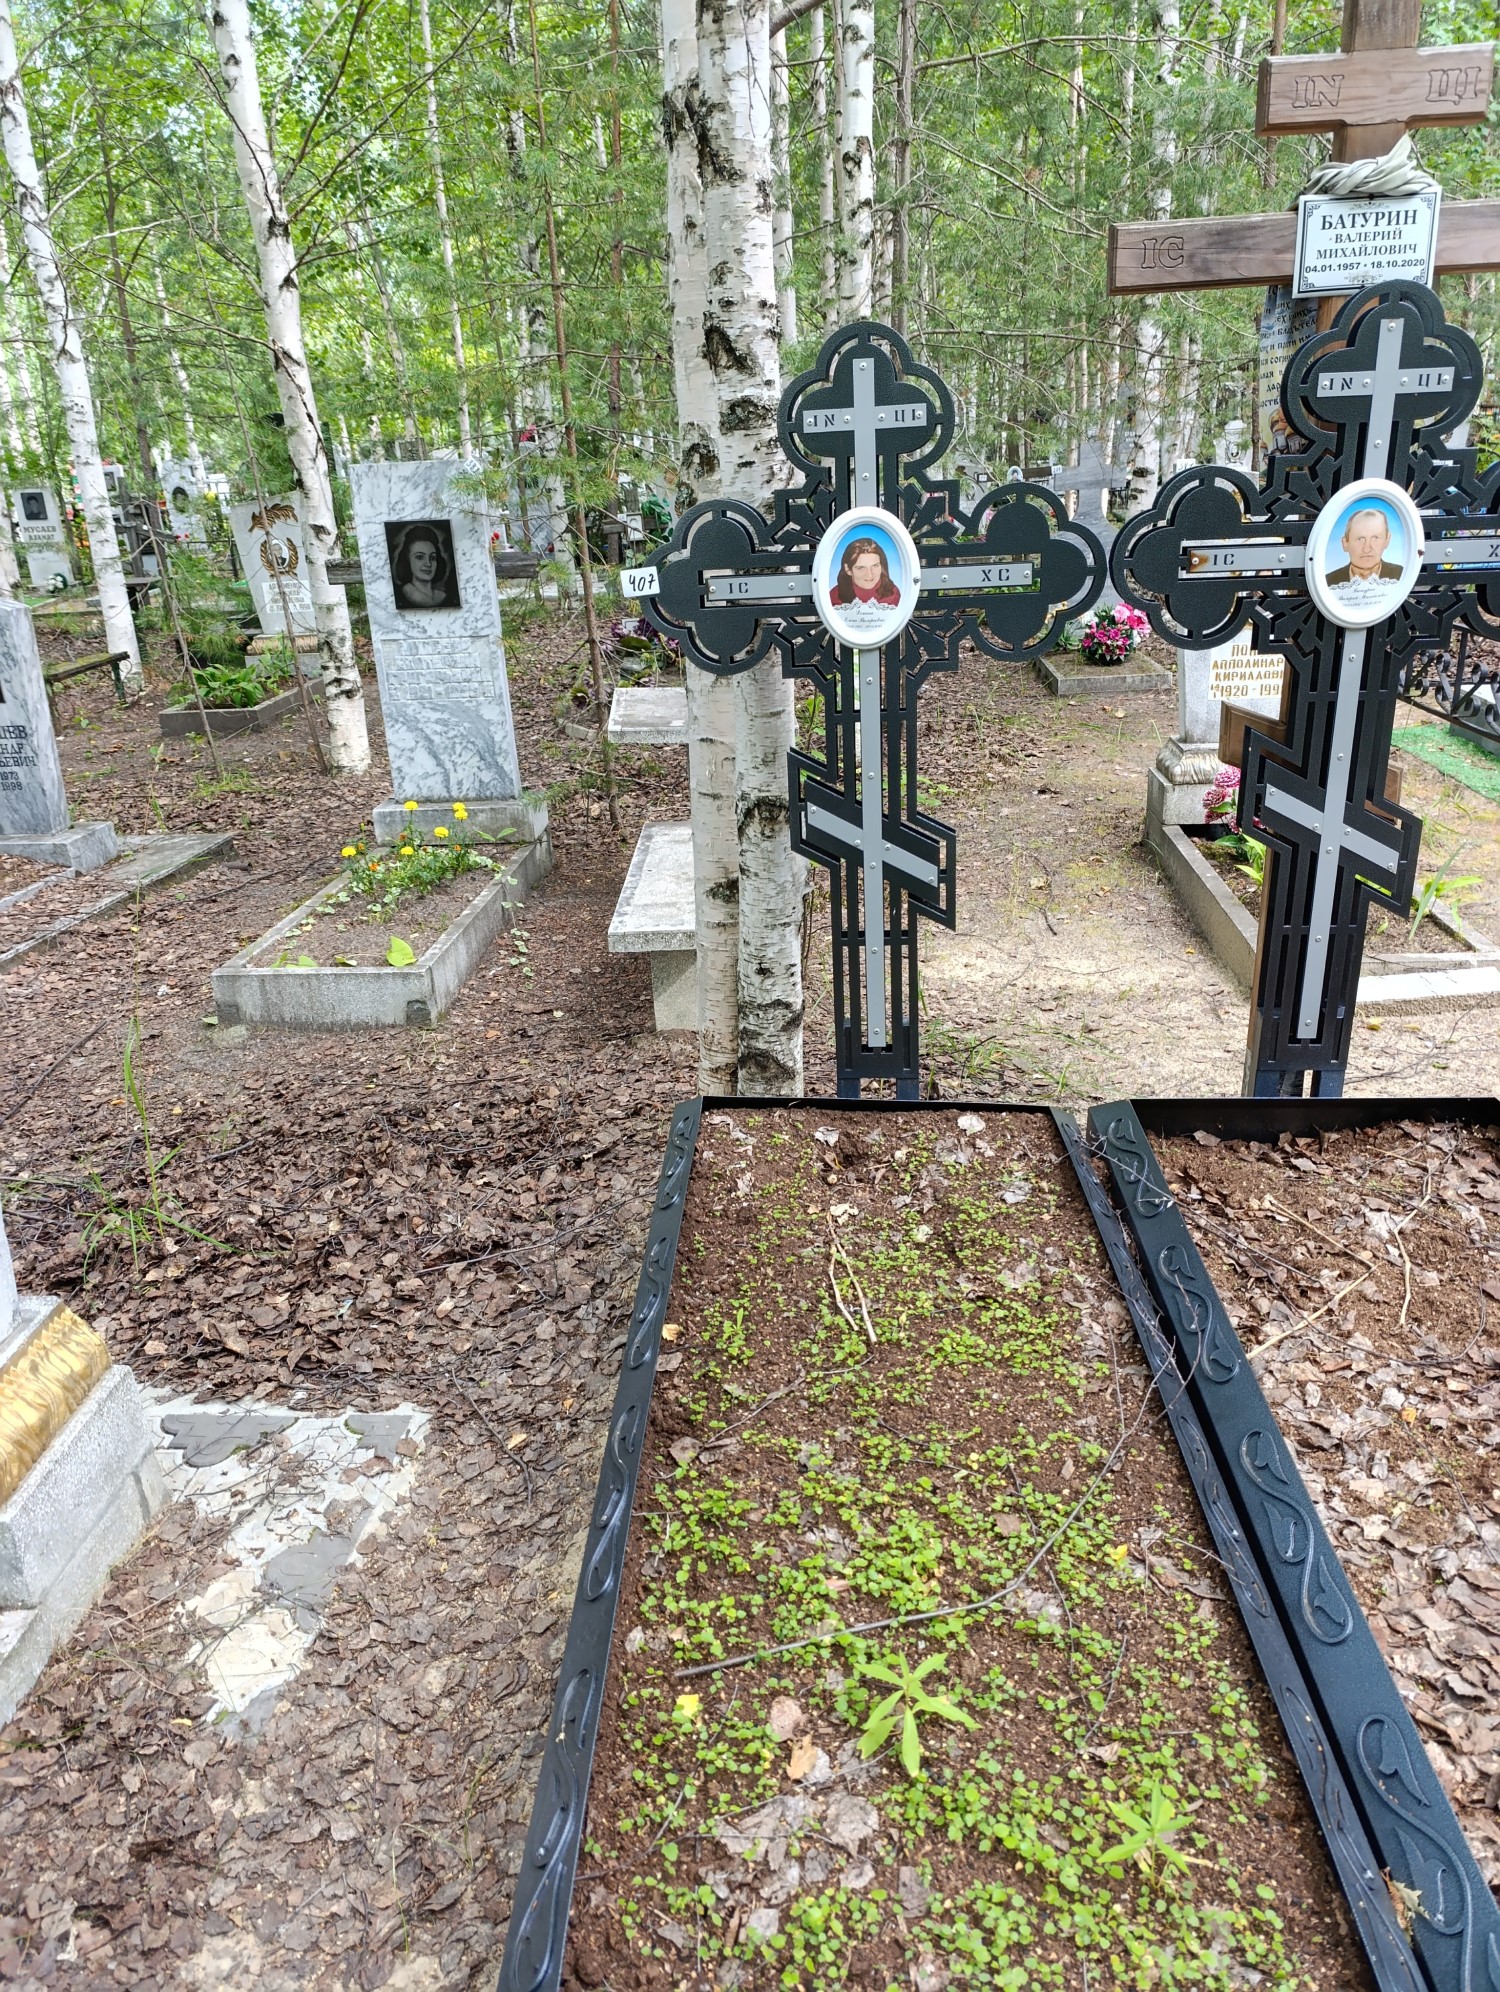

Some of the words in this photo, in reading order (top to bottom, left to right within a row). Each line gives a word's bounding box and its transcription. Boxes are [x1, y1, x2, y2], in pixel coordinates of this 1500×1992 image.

[1321, 209, 1418, 231] БАТУРИН
[1334, 228, 1403, 244] ВАЛЕРИЙ
[1316, 243, 1418, 260] МИХАЙЛОВИЧ
[1305, 262, 1361, 274] 04.01.1957
[1371, 258, 1425, 269] 18.10.2020
[23, 525, 57, 533] МУСАЕВ
[628, 573, 656, 592] 407
